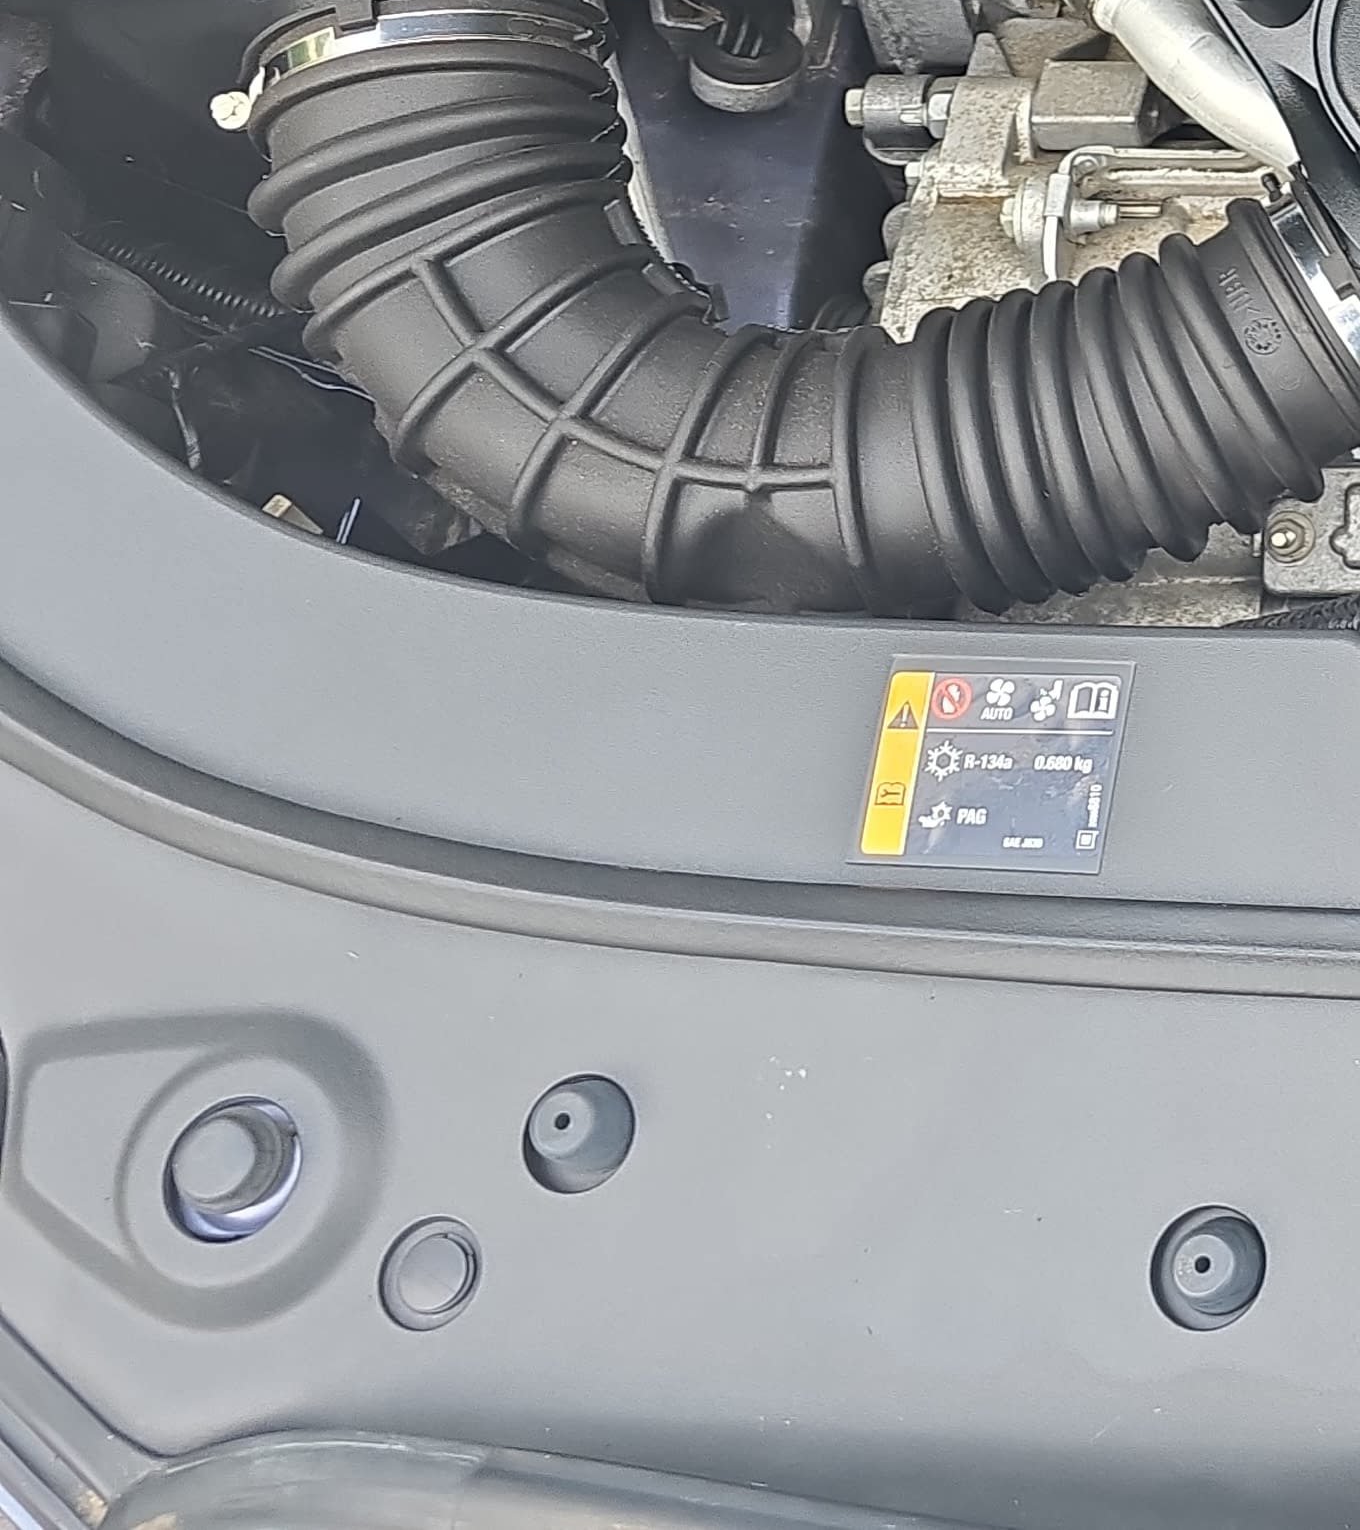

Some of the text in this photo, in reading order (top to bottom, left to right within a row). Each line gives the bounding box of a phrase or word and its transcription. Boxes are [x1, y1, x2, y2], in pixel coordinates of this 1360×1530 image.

[980, 707, 1014, 721] AUTO
[963, 753, 1094, 775] R-134a 0.680 kg
[955, 807, 988, 826] PAG
